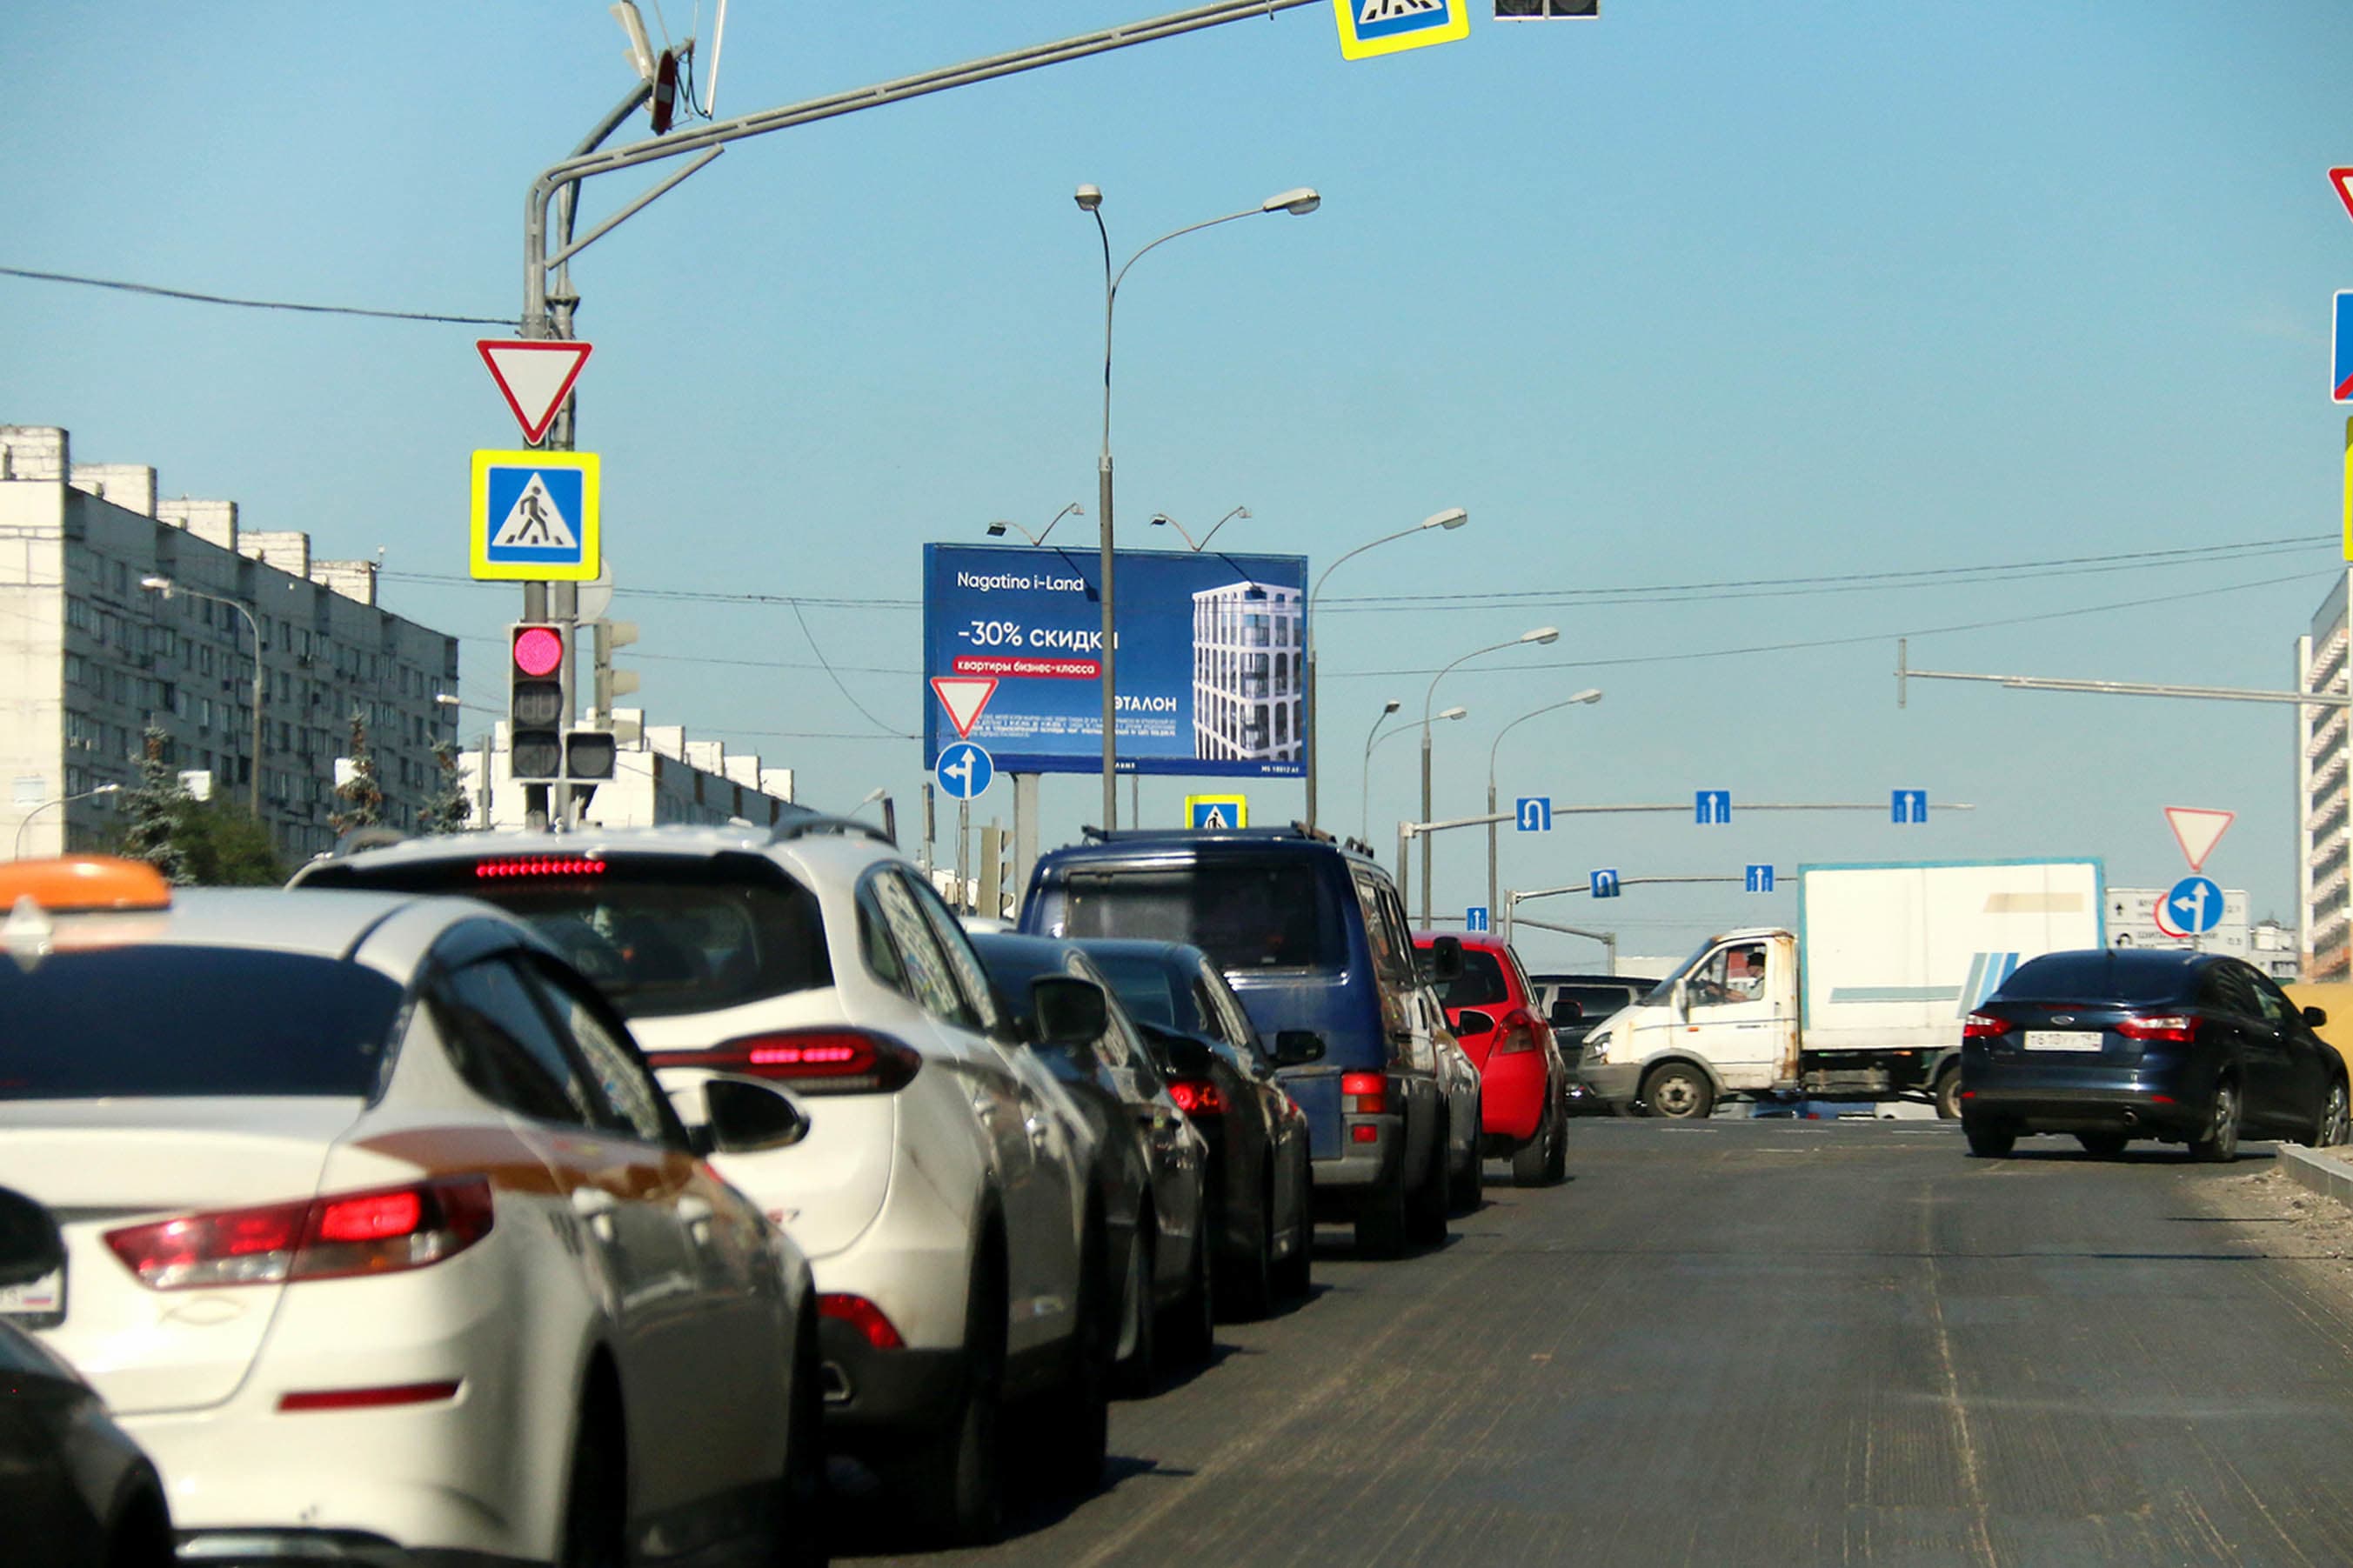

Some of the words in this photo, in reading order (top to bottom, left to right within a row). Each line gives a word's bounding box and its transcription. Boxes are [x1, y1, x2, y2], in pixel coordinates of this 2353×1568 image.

[957, 570, 1031, 592] Nagatino
[1033, 574, 1085, 591] i-Land
[958, 620, 1024, 646] -30%
[957, 659, 1012, 674] квартиры
[1013, 660, 1096, 675] бизнес-класса
[1113, 694, 1177, 712] ЭТАЛОН
